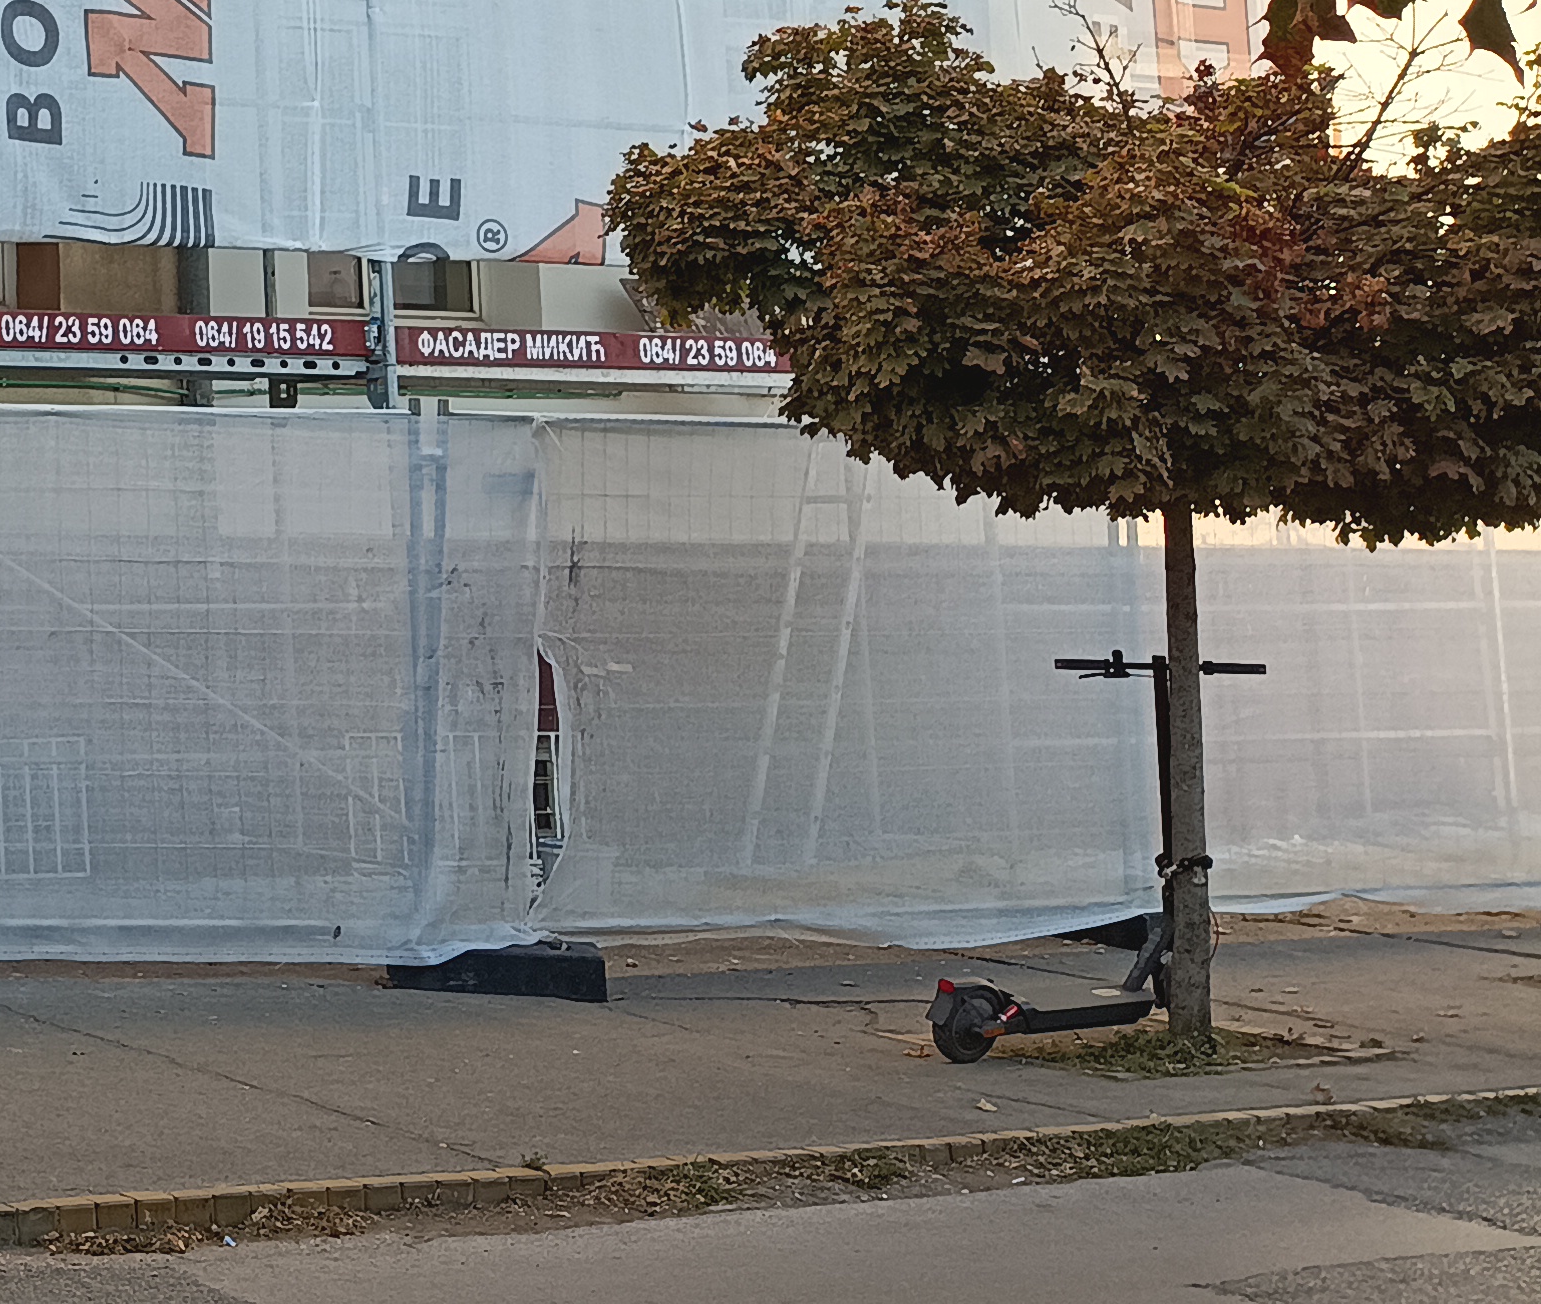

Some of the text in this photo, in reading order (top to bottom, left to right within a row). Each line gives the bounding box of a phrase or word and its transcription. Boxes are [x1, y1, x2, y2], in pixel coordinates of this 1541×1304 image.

[0, 313, 49, 343] 064/
[53, 315, 82, 344] 23
[87, 317, 113, 345] 59
[118, 318, 159, 346] 064
[194, 320, 238, 349] 064/
[245, 322, 265, 349] 19
[270, 322, 292, 350] 15
[295, 323, 334, 351] 542
[417, 330, 778, 368] ФАСАДЕР МИКИЋ 064/ 23 59 064
